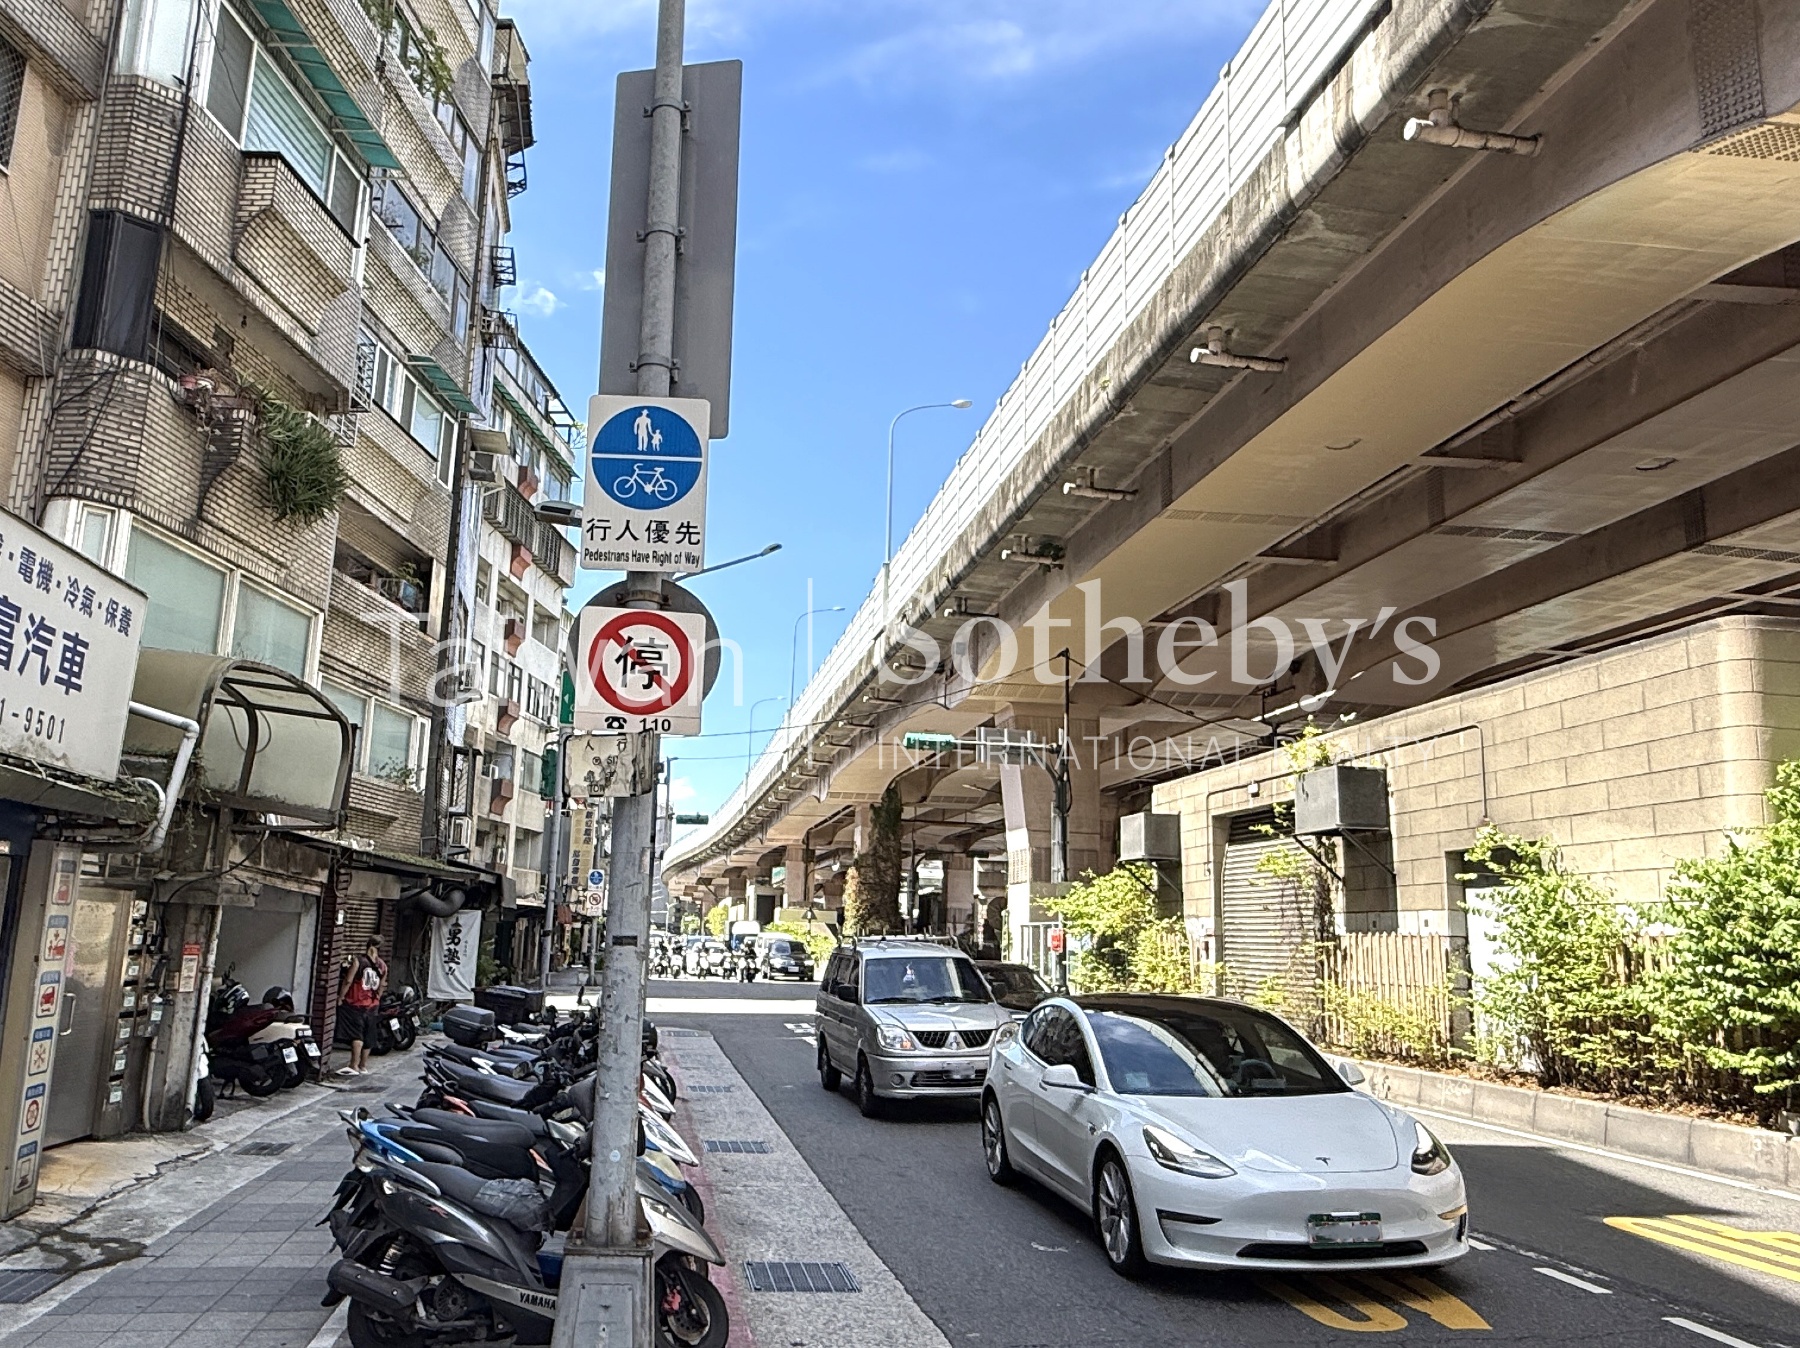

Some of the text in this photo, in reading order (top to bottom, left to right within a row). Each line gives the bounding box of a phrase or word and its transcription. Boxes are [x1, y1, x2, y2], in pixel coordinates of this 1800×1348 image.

[586, 517, 701, 546] 行人優先
[583, 547, 700, 569] Pedestrians Have Right of Way
[614, 635, 669, 690] 停
[639, 717, 671, 732] 110
[520, 1292, 556, 1310] YAMAHA
